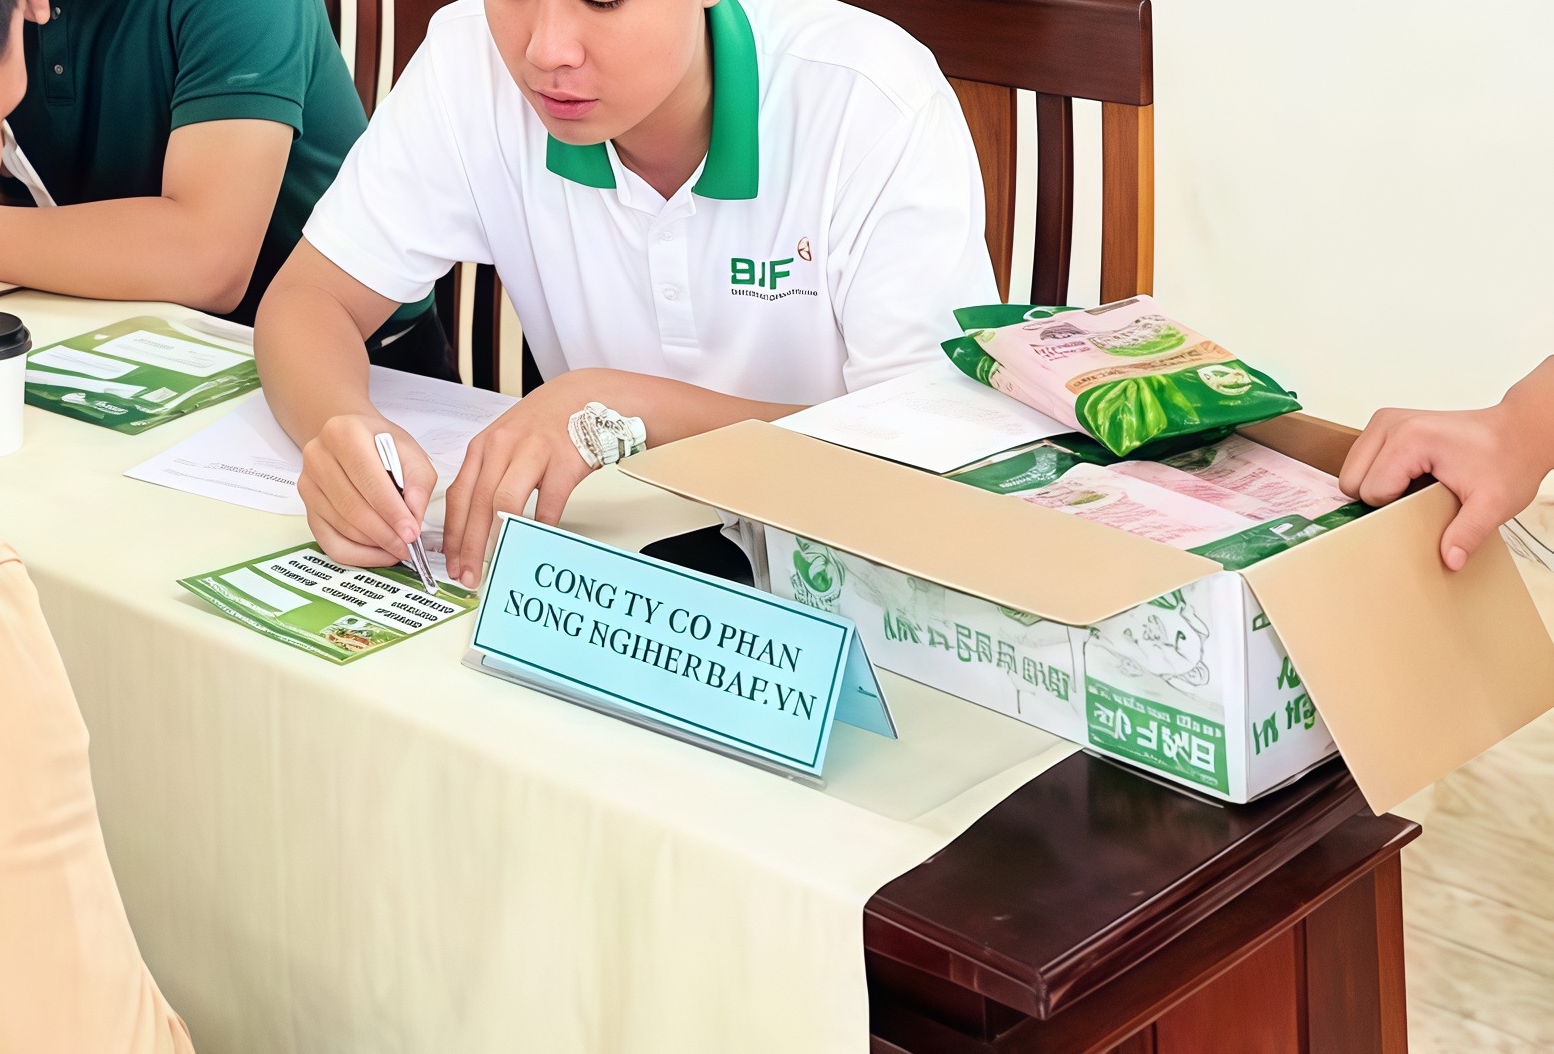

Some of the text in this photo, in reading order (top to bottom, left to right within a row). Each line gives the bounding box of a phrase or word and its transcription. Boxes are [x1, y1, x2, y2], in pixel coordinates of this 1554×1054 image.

[534, 562, 804, 673] CONG TY CO PHAN
